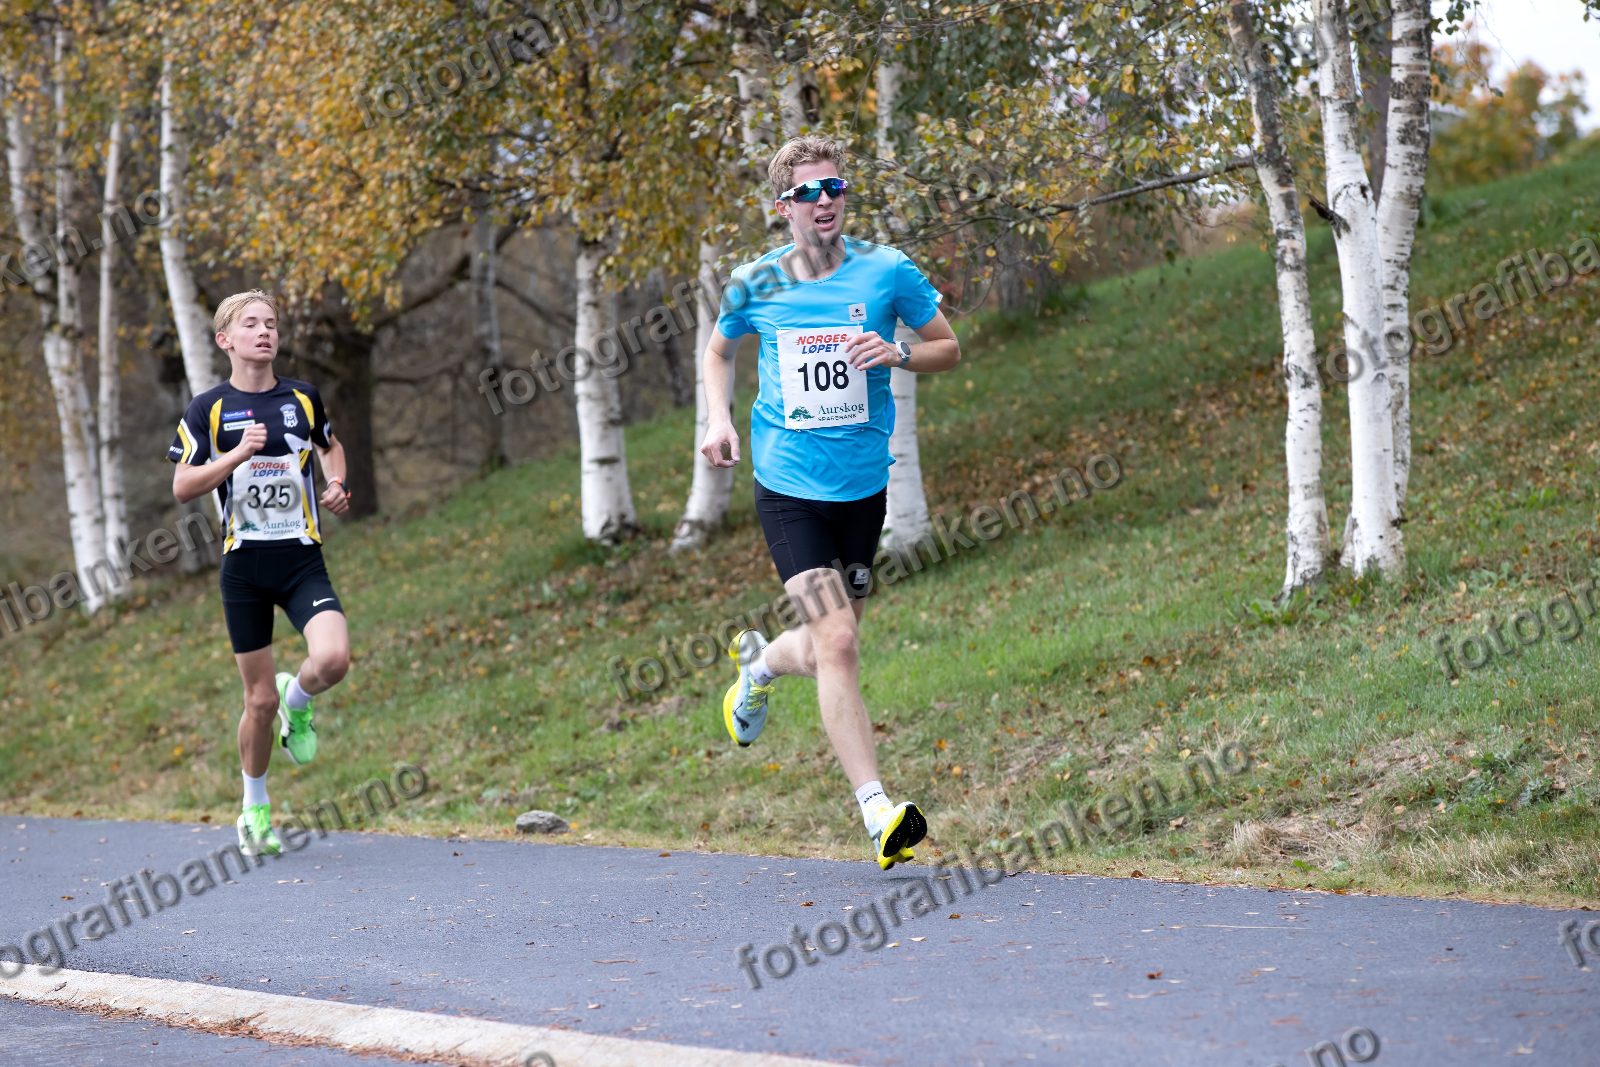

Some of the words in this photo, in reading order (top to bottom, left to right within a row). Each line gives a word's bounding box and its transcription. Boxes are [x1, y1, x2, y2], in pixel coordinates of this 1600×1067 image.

[796, 334, 848, 345] NORGES
[802, 343, 840, 354] LØPET
[797, 360, 849, 391] 108
[818, 403, 865, 414] Aurskog
[249, 461, 290, 470] NORGES
[253, 469, 286, 477] LØPET
[247, 484, 291, 509] 325
[263, 519, 301, 529] Aurskog
